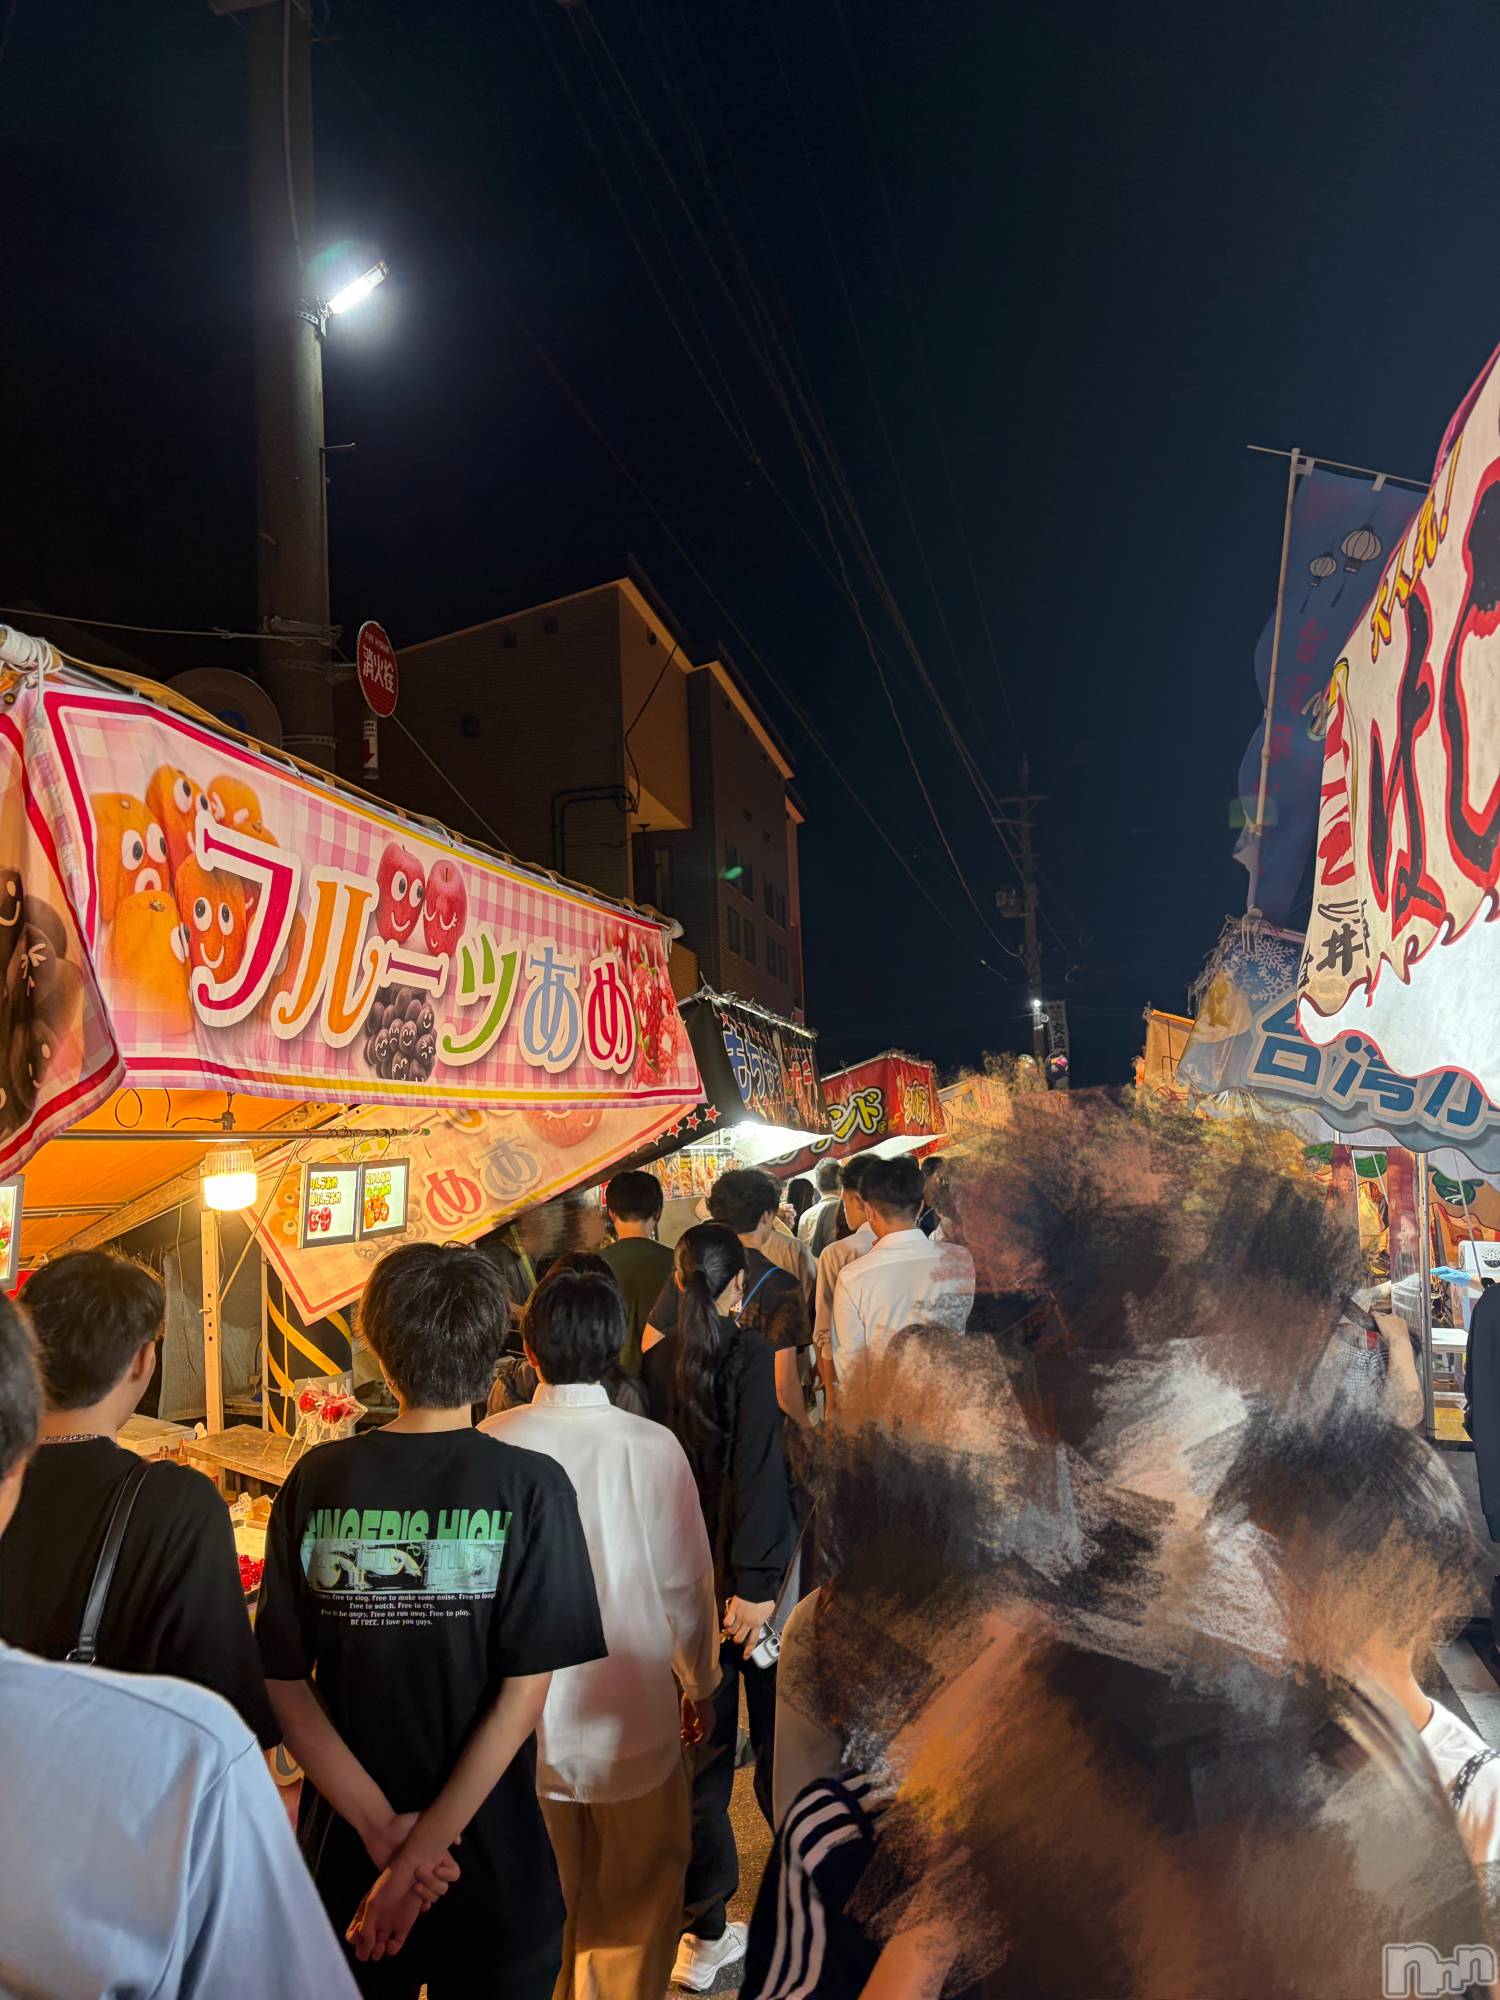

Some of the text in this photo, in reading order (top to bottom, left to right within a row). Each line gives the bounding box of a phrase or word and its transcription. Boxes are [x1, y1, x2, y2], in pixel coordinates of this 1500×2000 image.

[361, 644, 396, 694] 消火栓
[192, 811, 640, 1074] フルーツあめ
[1251, 998, 1500, 1130] 台湾カ
[481, 1592, 496, 1600] laug
[386, 1618, 401, 1626] love
[415, 1619, 433, 1627] guys.
[455, 1609, 472, 1618] play.
